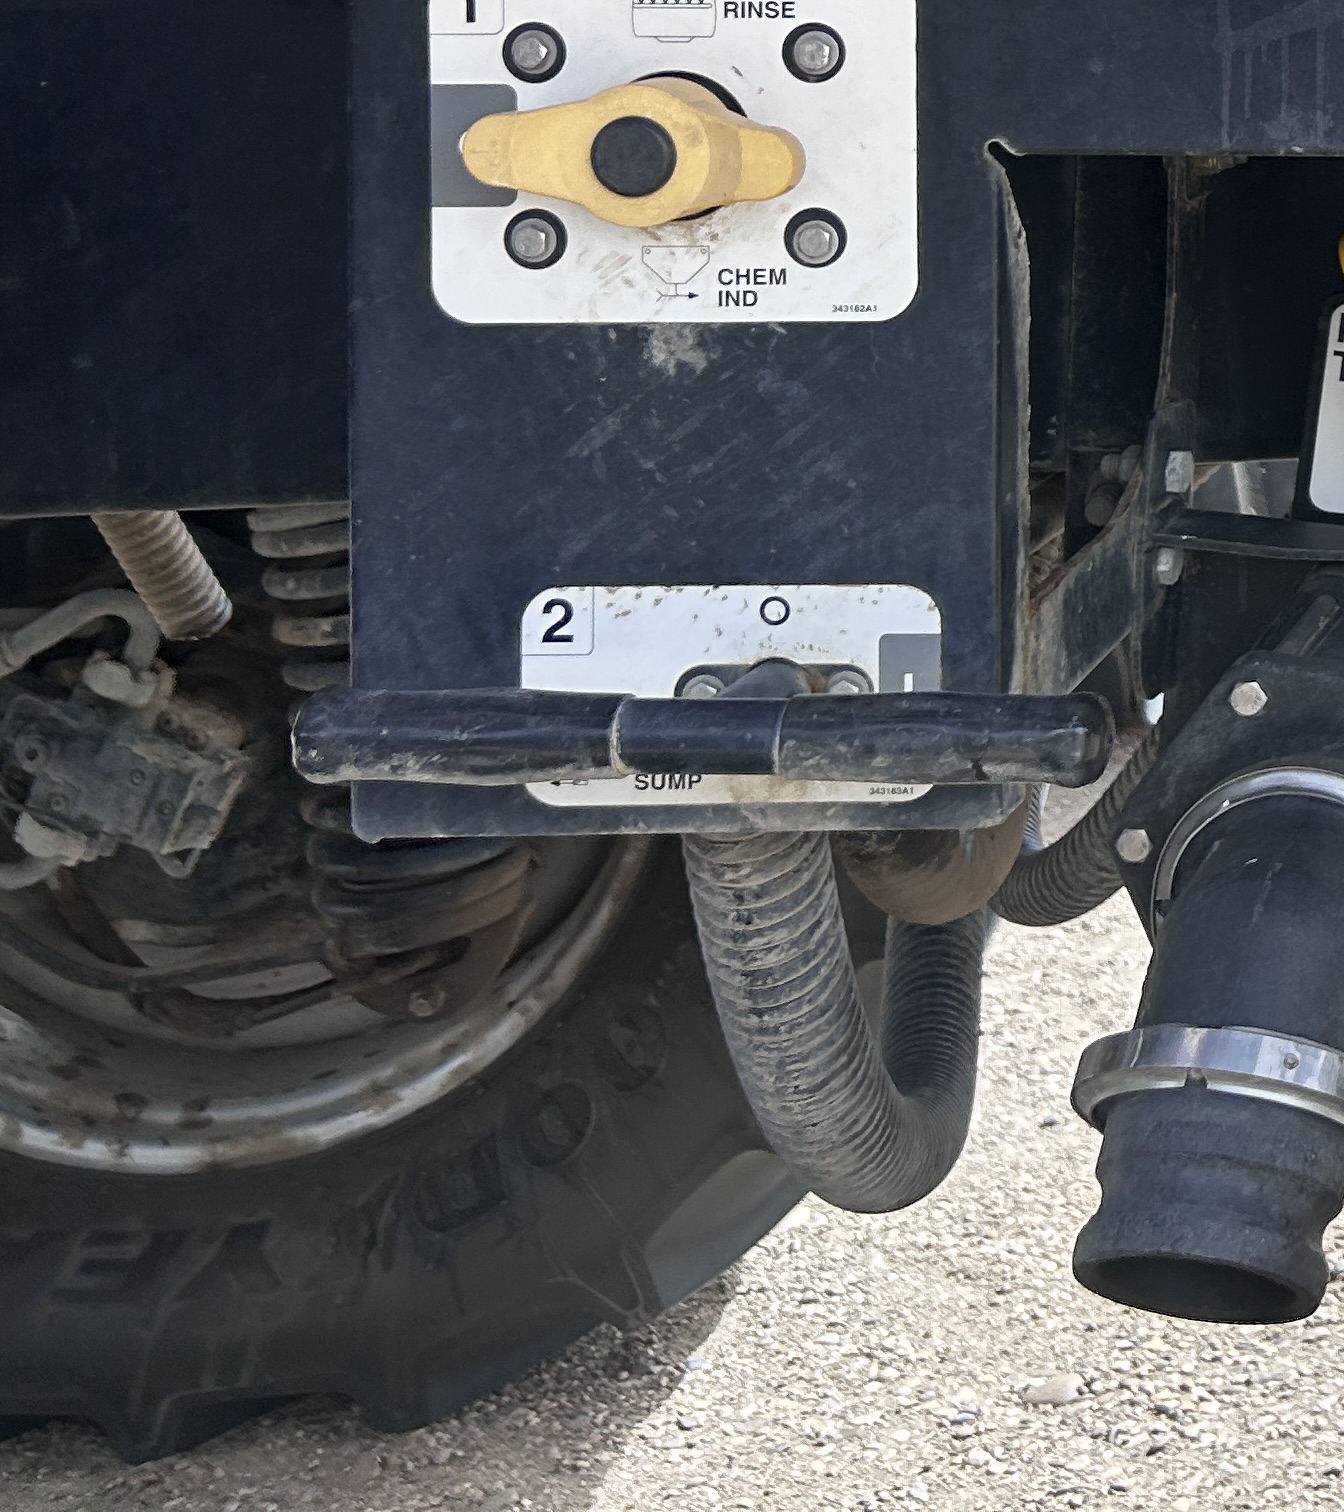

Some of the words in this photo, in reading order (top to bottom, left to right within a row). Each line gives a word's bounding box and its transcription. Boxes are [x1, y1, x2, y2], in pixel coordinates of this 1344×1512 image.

[723, 1, 795, 19] RINSE
[717, 268, 787, 285] CHEM
[717, 290, 758, 307] IND
[541, 598, 574, 643] 2
[634, 772, 702, 790] SUMP
